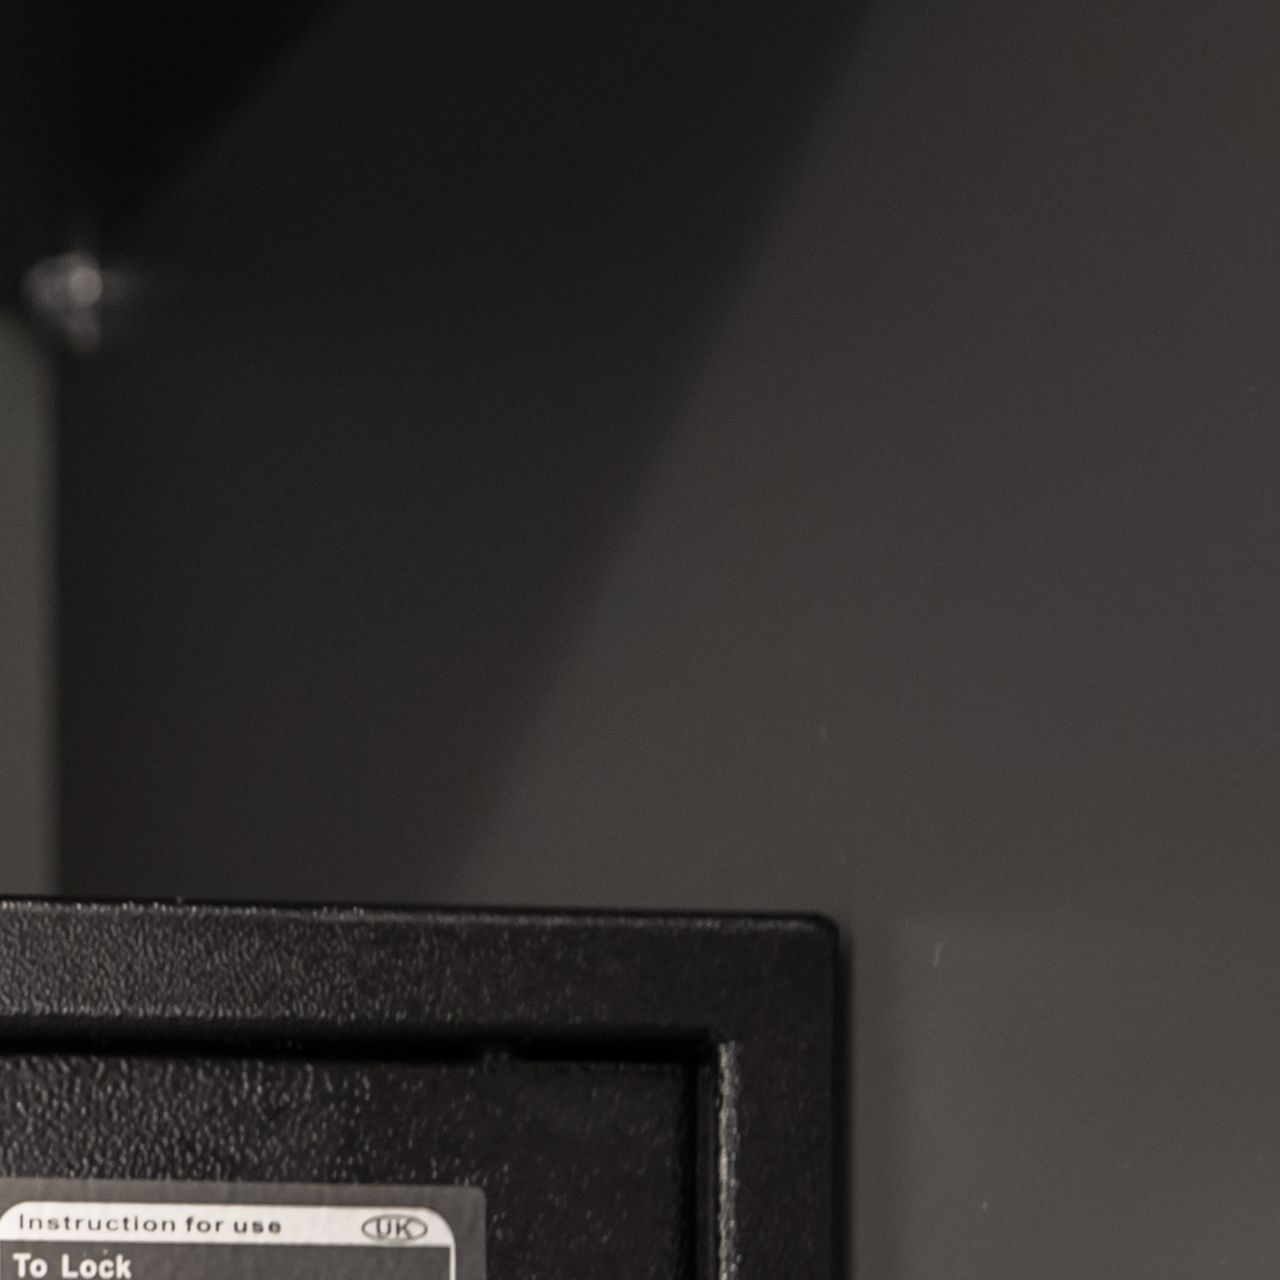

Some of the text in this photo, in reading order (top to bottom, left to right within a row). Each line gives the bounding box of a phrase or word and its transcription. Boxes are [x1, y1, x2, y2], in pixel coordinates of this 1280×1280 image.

[19, 1213, 282, 1234] Instruction for use
[376, 1218, 414, 1239] UK
[12, 1252, 132, 1280] To Lock
